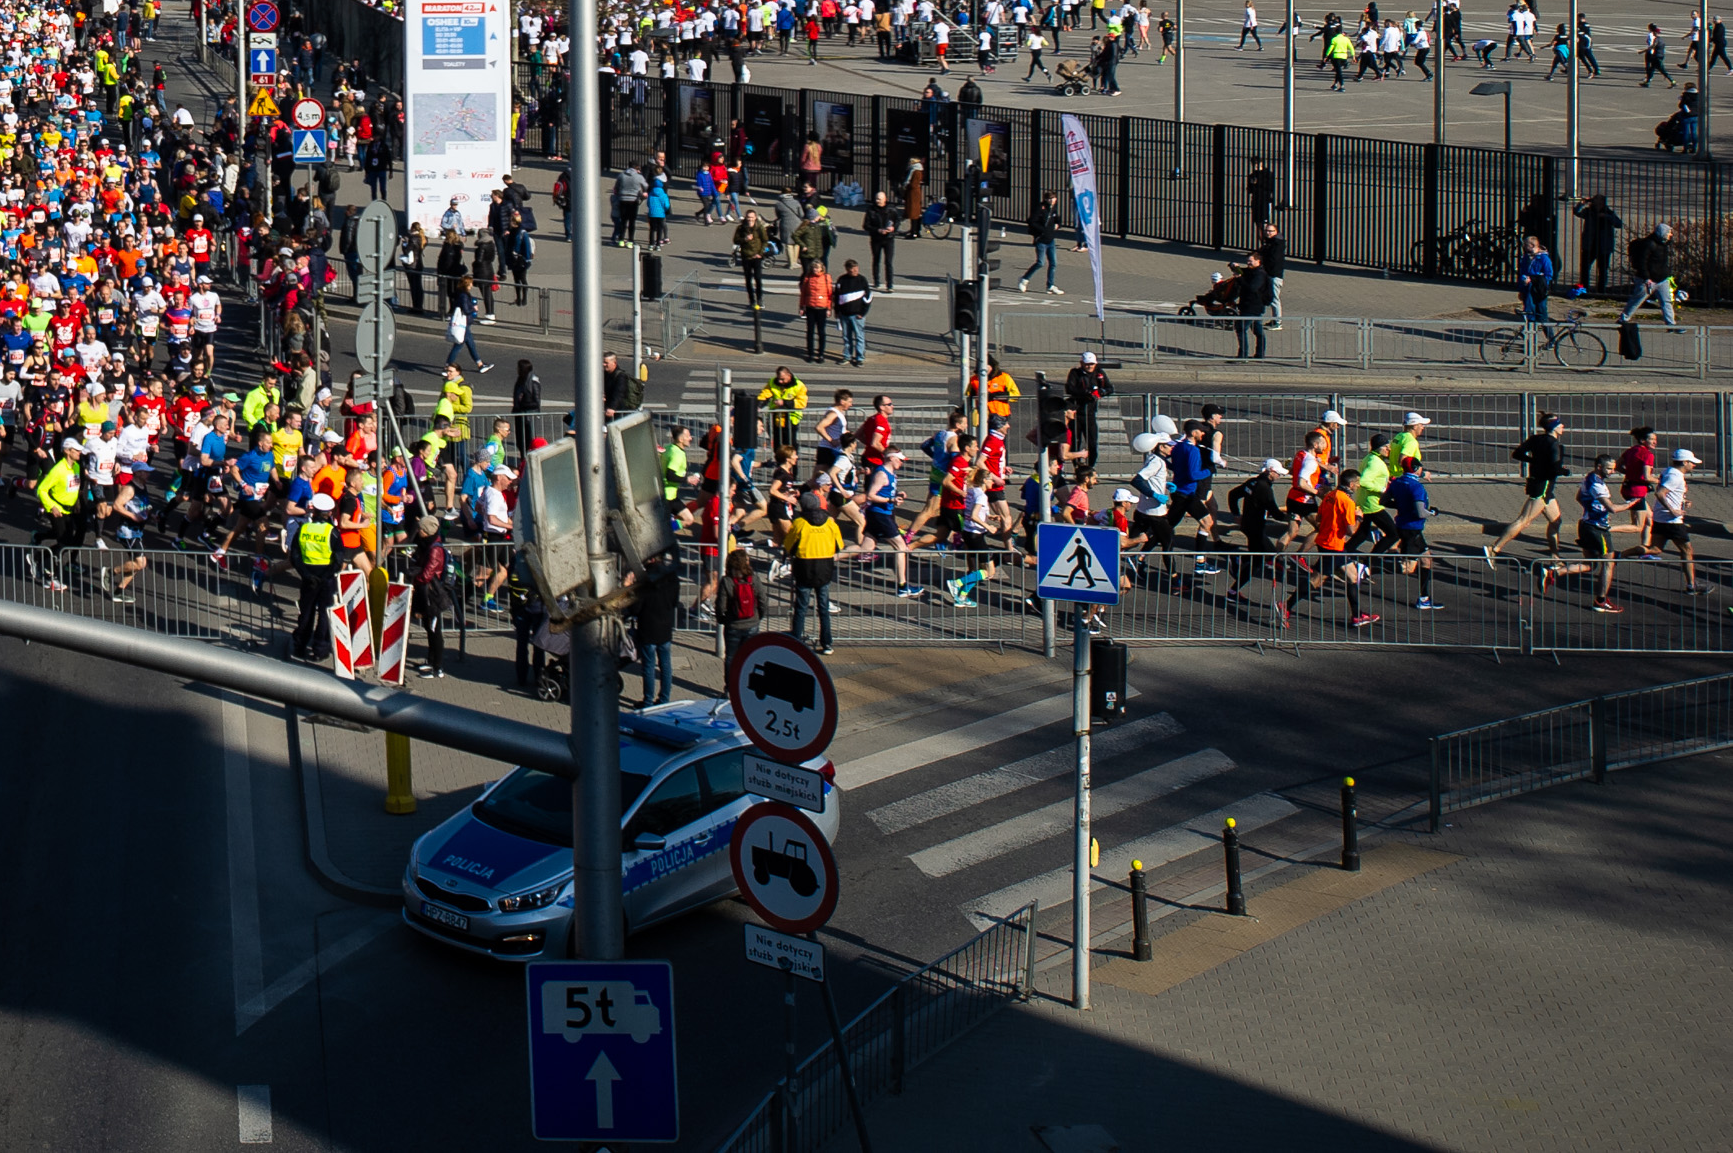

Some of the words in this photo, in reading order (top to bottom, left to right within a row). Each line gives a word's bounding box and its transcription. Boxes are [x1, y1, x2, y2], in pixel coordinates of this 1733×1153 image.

[426, 18, 459, 26] OSHEE
[302, 533, 326, 543] POLICJA
[765, 709, 801, 741] 2,5t
[755, 762, 772, 776] Nie
[774, 768, 810, 787] dotyczy
[748, 775, 772, 789] służb
[775, 782, 818, 803] miejskich
[442, 854, 495, 880] POLICJA
[650, 844, 695, 876] POLICJA
[748, 947, 774, 961] służb
[756, 933, 773, 947] Nie
[776, 941, 813, 961] dotyczy
[566, 986, 616, 1029] 5t
